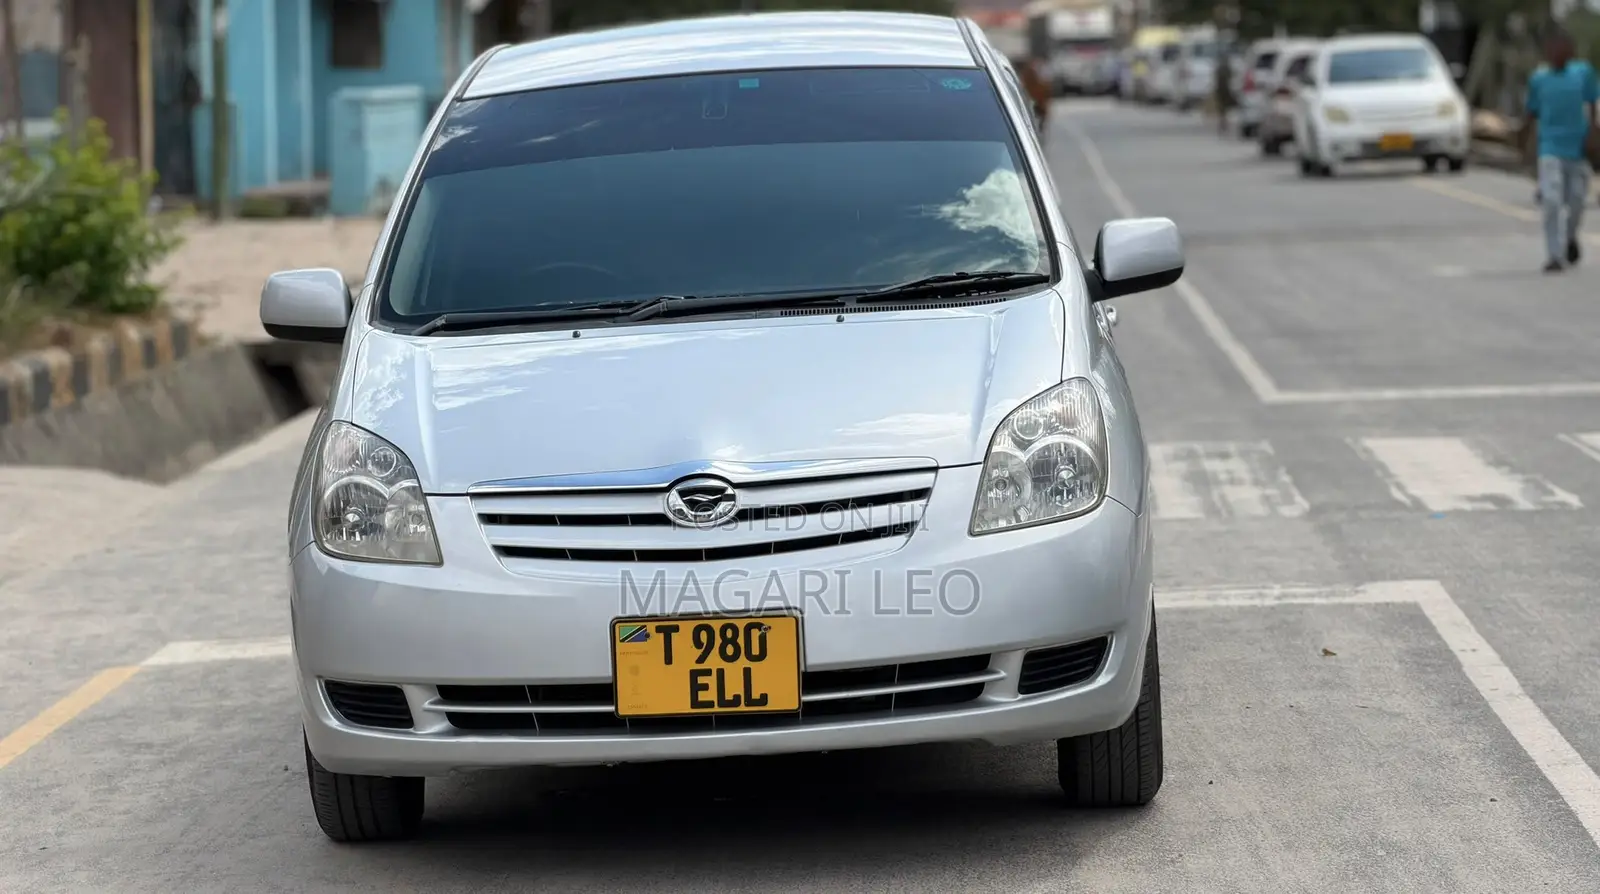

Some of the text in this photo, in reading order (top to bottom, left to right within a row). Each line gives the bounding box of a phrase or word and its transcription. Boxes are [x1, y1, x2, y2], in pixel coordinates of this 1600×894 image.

[655, 622, 768, 665] T 980
[689, 667, 768, 709] ELL
